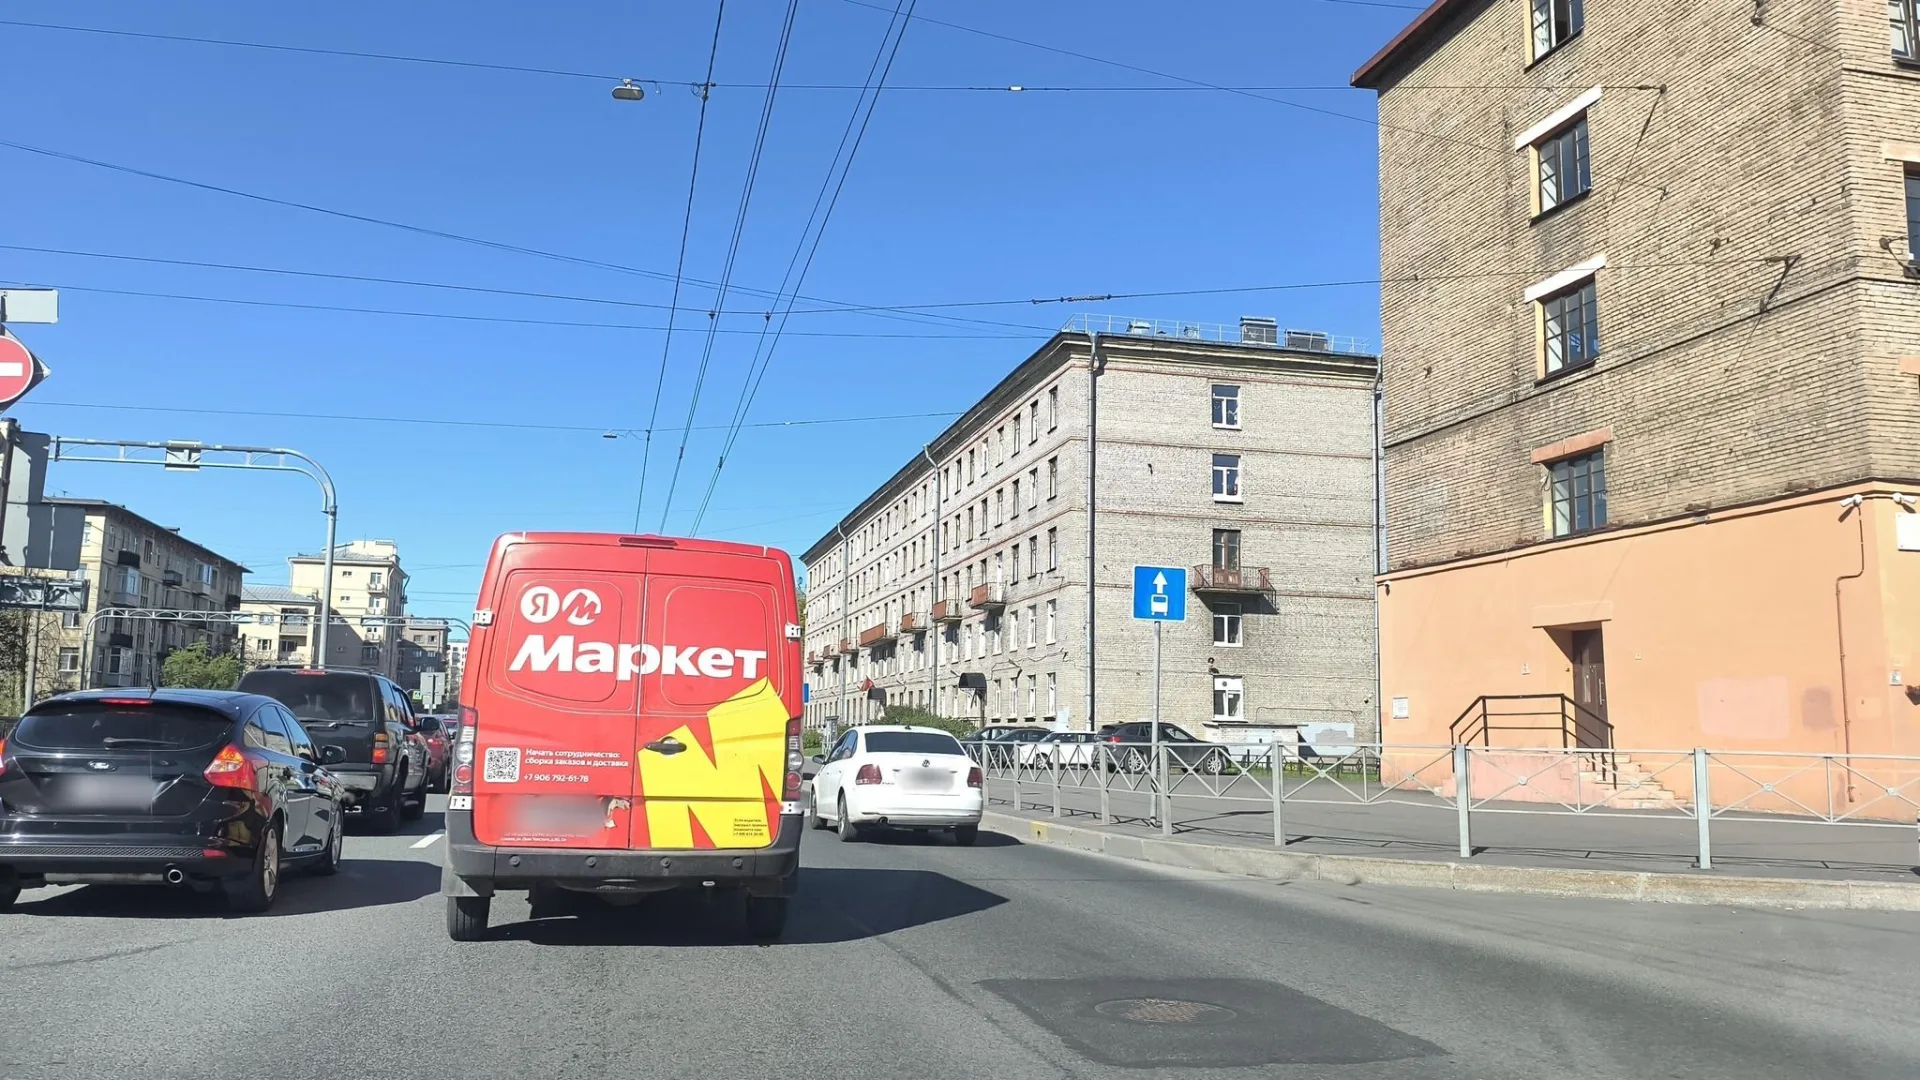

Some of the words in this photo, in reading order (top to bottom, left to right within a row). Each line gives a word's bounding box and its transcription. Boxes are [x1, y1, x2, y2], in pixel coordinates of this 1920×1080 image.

[508, 634, 767, 681] Маркет
[526, 748, 553, 756] Начать
[555, 750, 620, 758] сотрудничество:
[525, 757, 553, 766] сборка
[523, 774, 533, 782] +7
[534, 774, 550, 782] 906
[552, 774, 589, 783] 792-61-78
